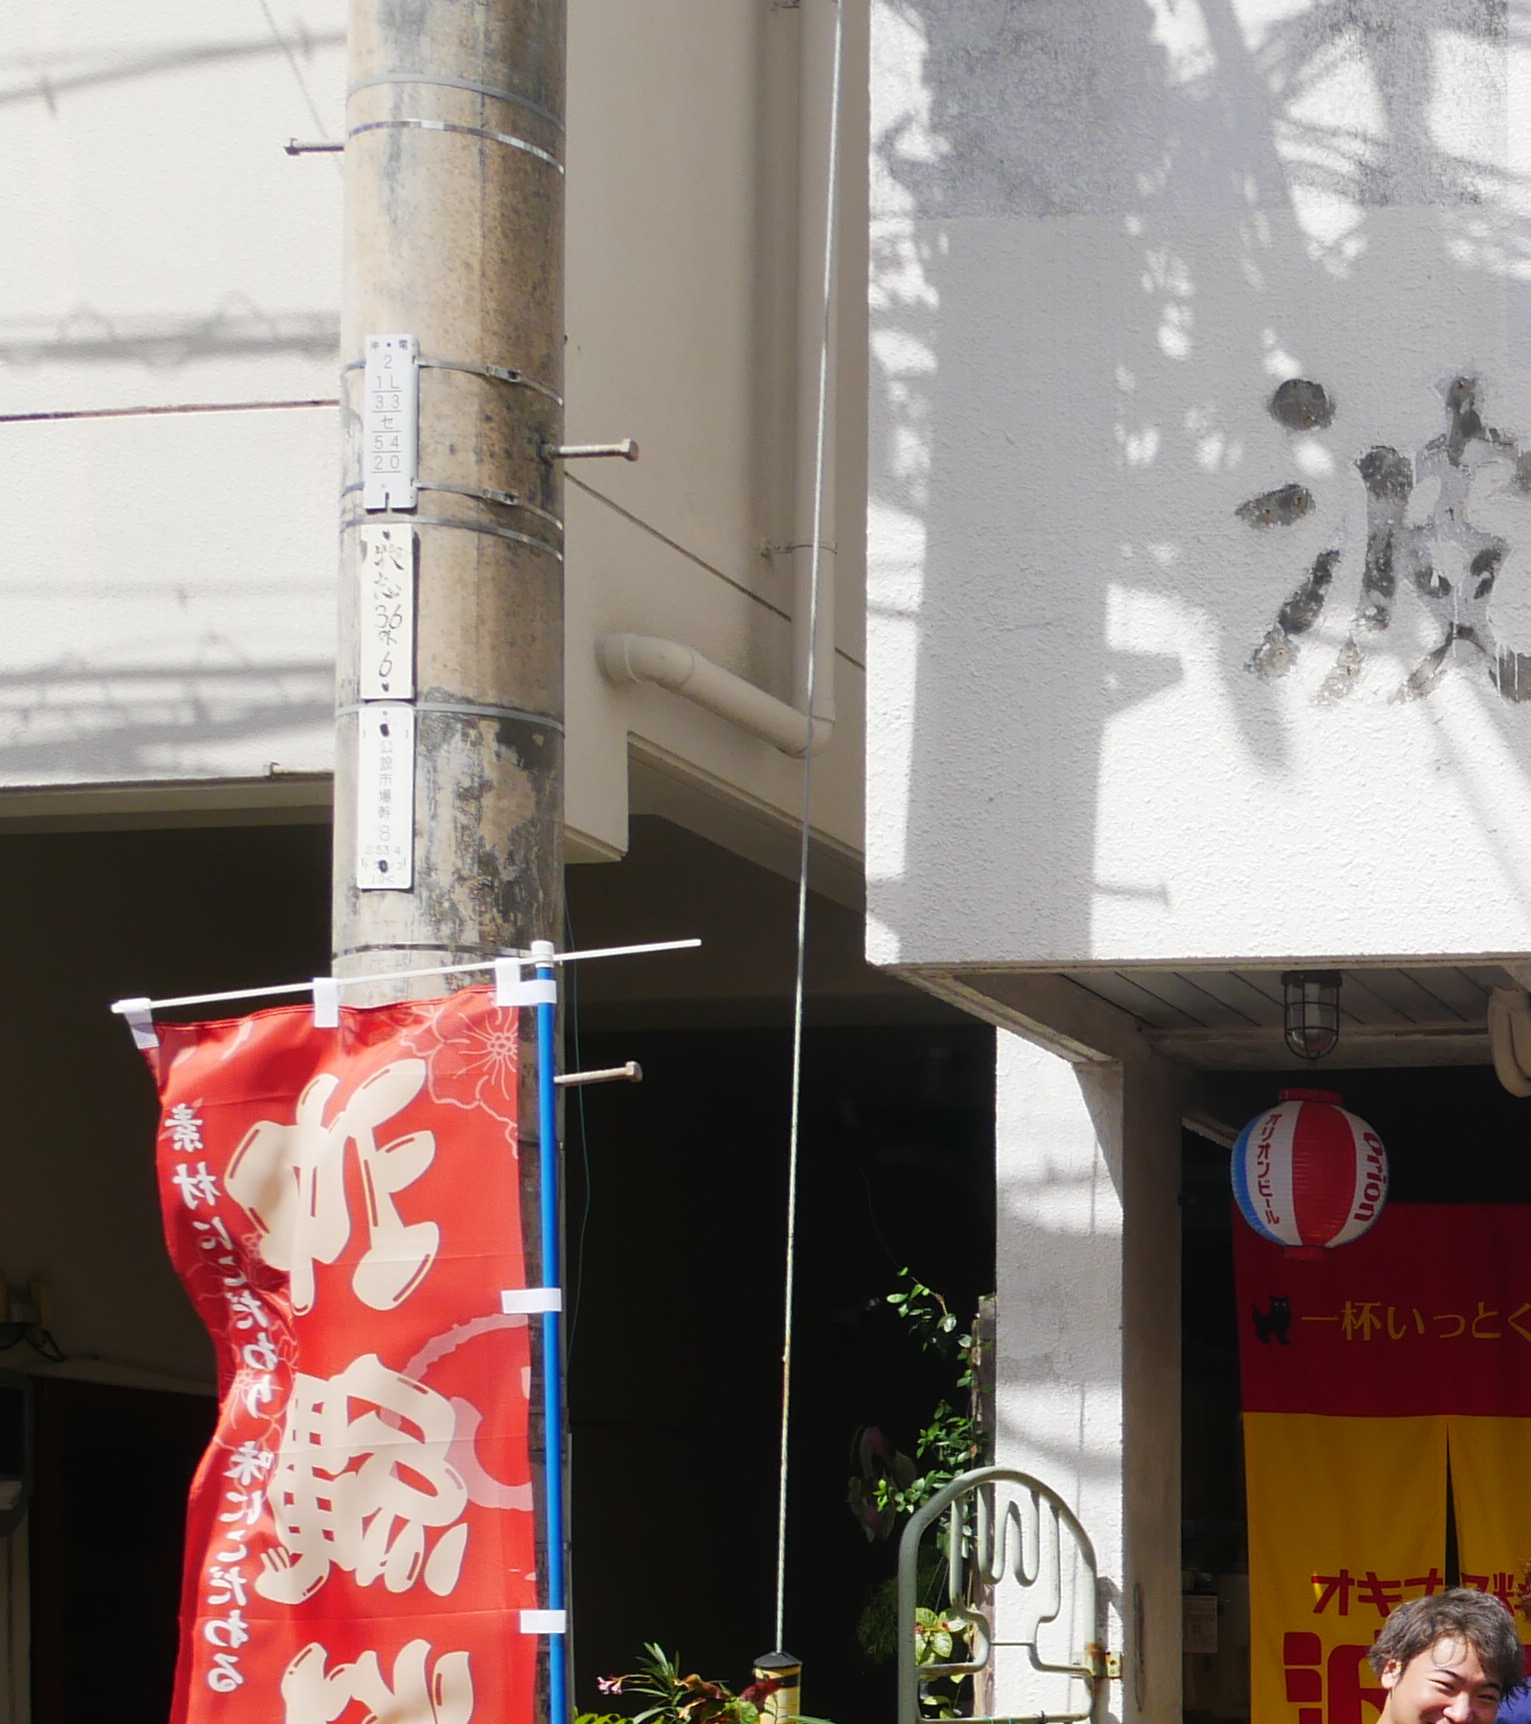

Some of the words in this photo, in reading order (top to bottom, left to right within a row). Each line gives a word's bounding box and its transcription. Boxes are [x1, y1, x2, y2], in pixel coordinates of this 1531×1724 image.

[384, 355, 392, 369] 2
[1257, 1114, 1282, 1225] オリオンビール
[1353, 1132, 1387, 1222] Orion
